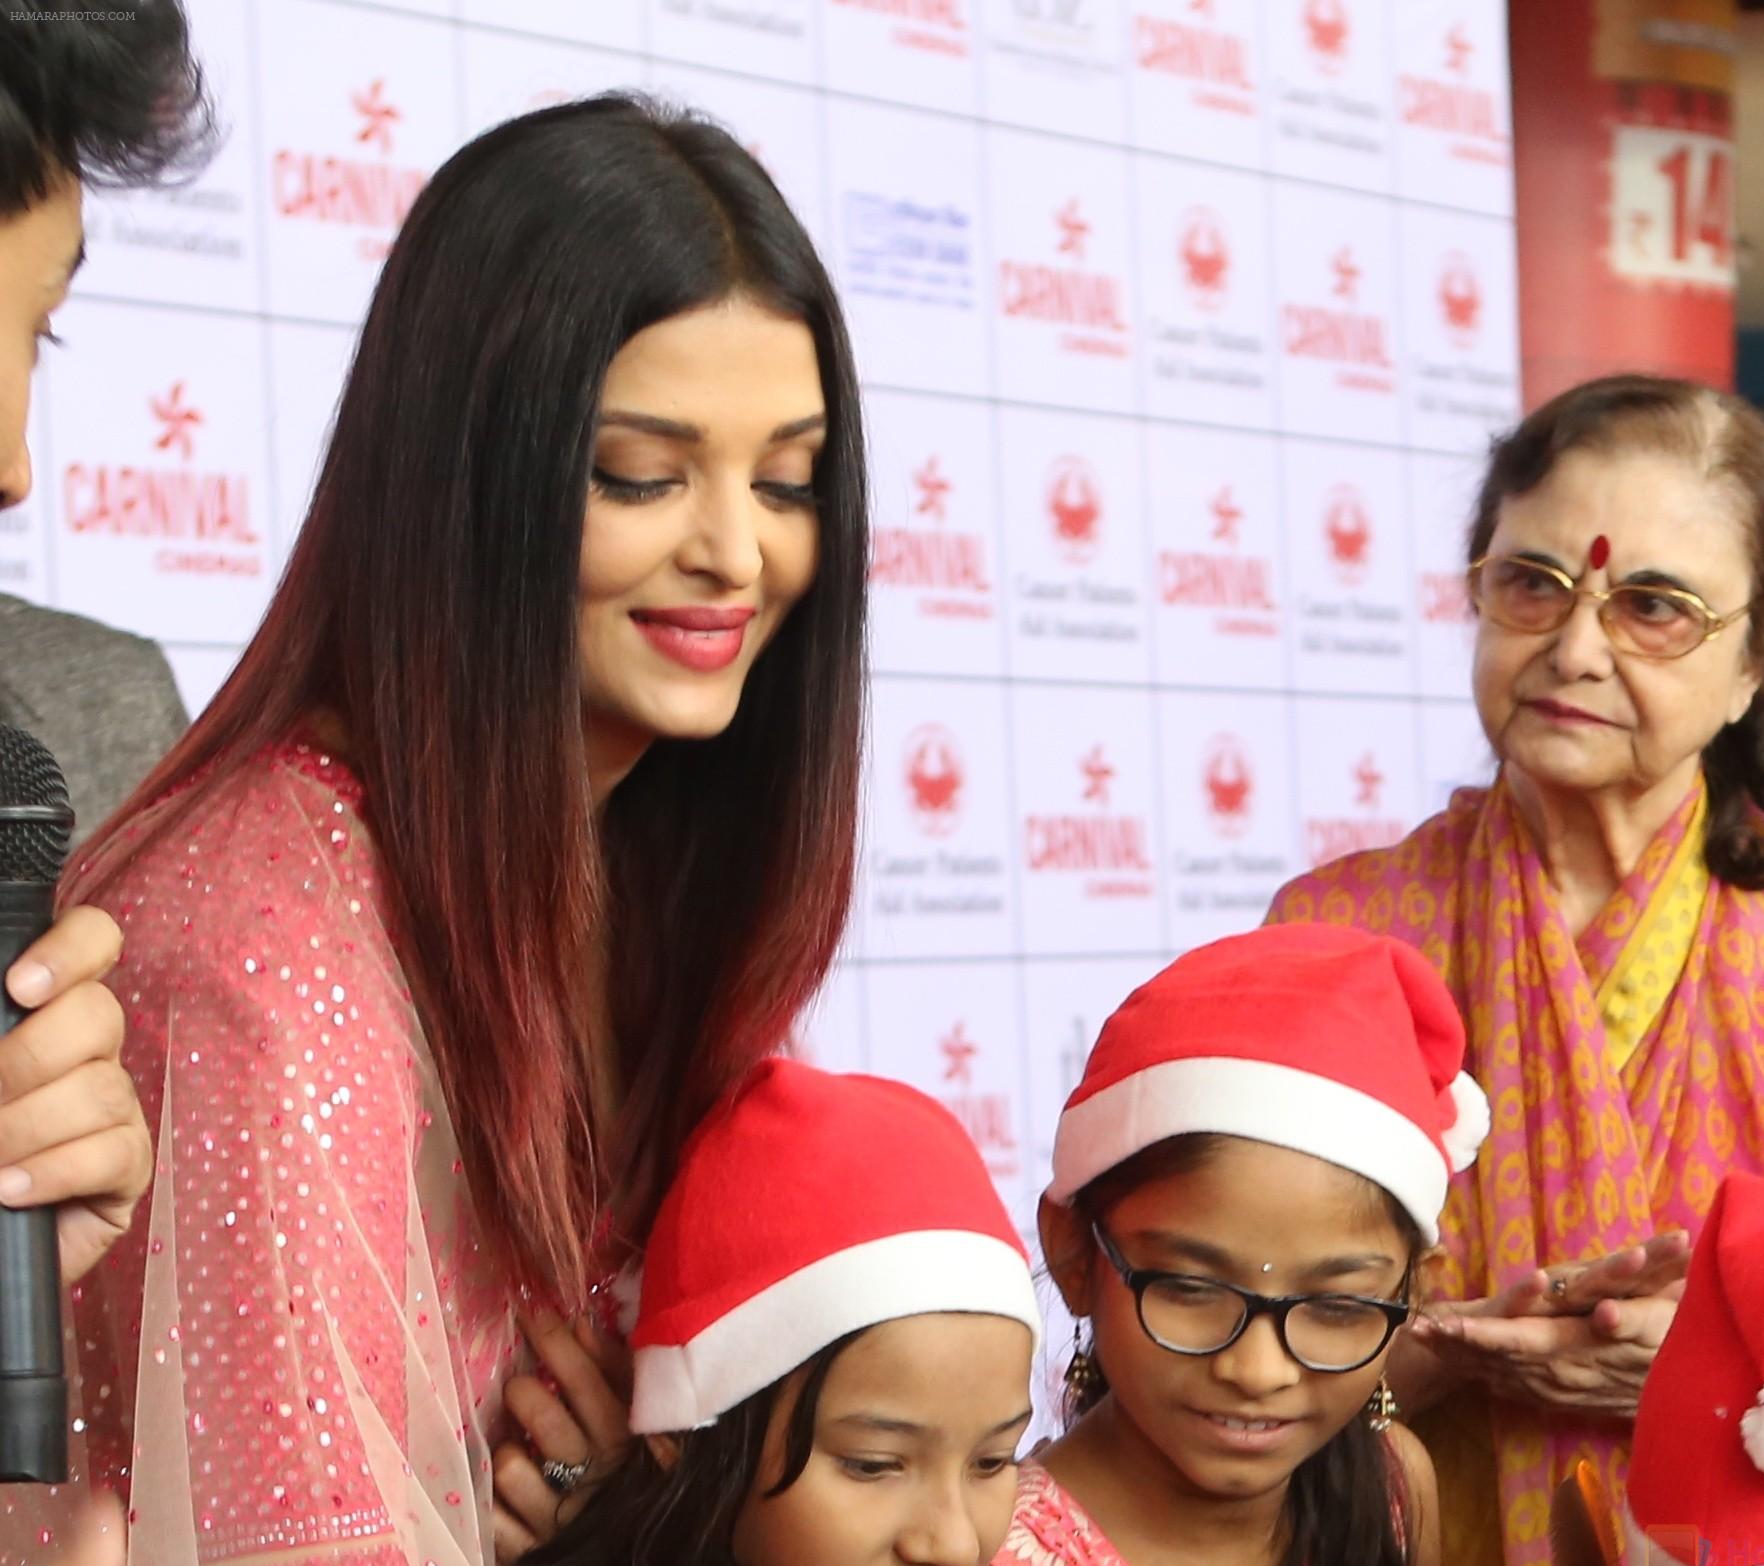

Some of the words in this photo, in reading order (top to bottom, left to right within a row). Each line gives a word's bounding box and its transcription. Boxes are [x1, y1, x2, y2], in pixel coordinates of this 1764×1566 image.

[998, 259, 1130, 333] CARNIVAL
[65, 463, 261, 544] CARNIVAL
[1159, 552, 1274, 612] CARNIVAL
[1027, 816, 1151, 872] CARNIVAL
